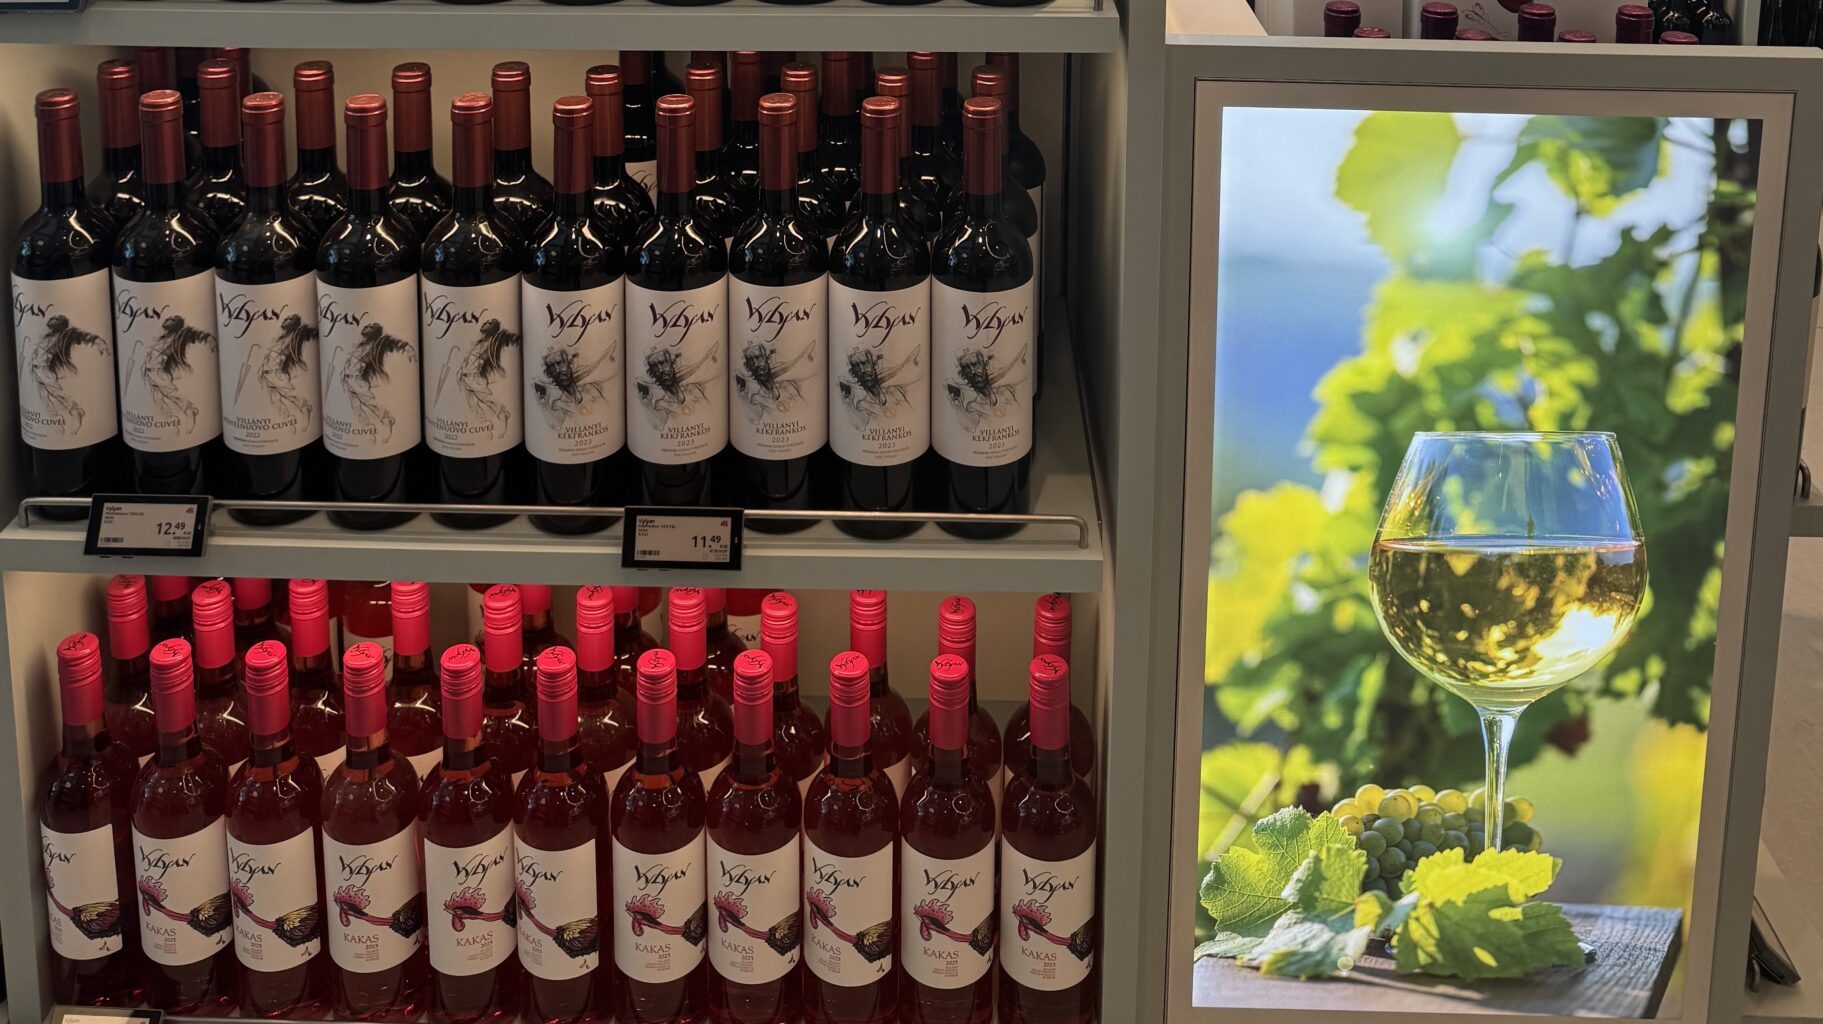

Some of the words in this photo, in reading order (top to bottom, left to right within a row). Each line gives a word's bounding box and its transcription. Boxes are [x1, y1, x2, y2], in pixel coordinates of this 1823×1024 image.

[156, 521, 186, 535] 12.49
[691, 535, 722, 548] 11.49
[145, 919, 177, 937] KAKAS
[343, 932, 380, 944] KAKAS
[456, 931, 494, 947] KAKAS
[810, 933, 842, 955] KAKAS
[634, 942, 671, 953] KAKAS
[720, 937, 754, 954] KAKAS
[923, 946, 959, 959] KAKAS
[1021, 946, 1057, 961] KAKAS
